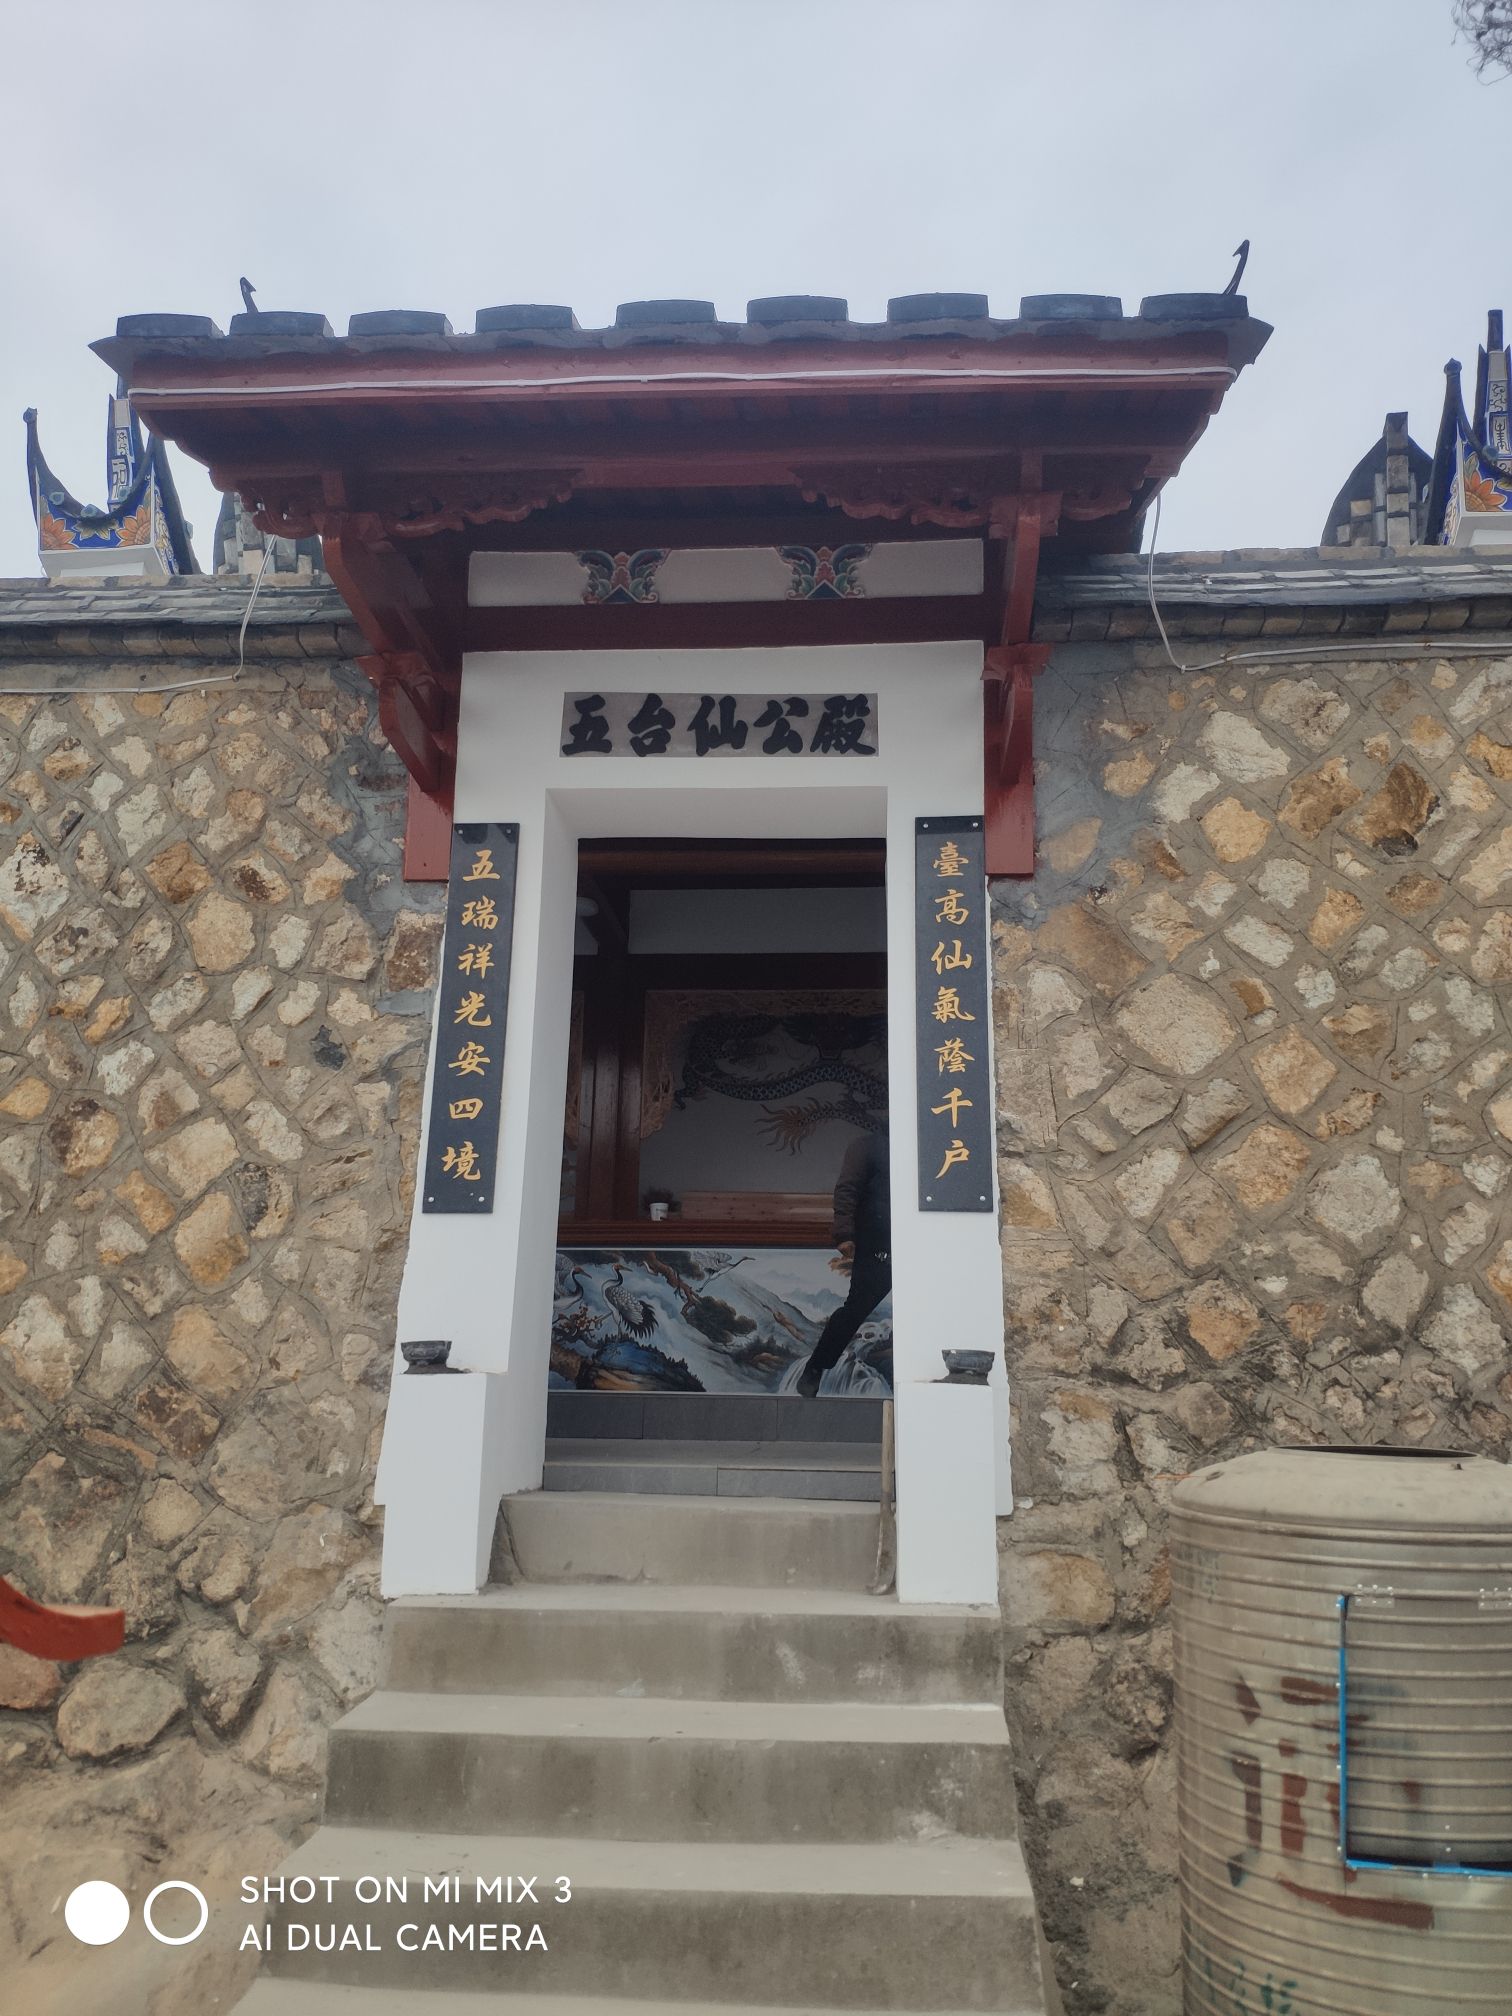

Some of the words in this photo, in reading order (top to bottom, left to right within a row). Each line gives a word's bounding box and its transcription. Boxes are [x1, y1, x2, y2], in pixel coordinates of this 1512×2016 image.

[561, 693, 877, 757] 五台仙公殿
[440, 849, 501, 1181] 五瑞祥光安四境
